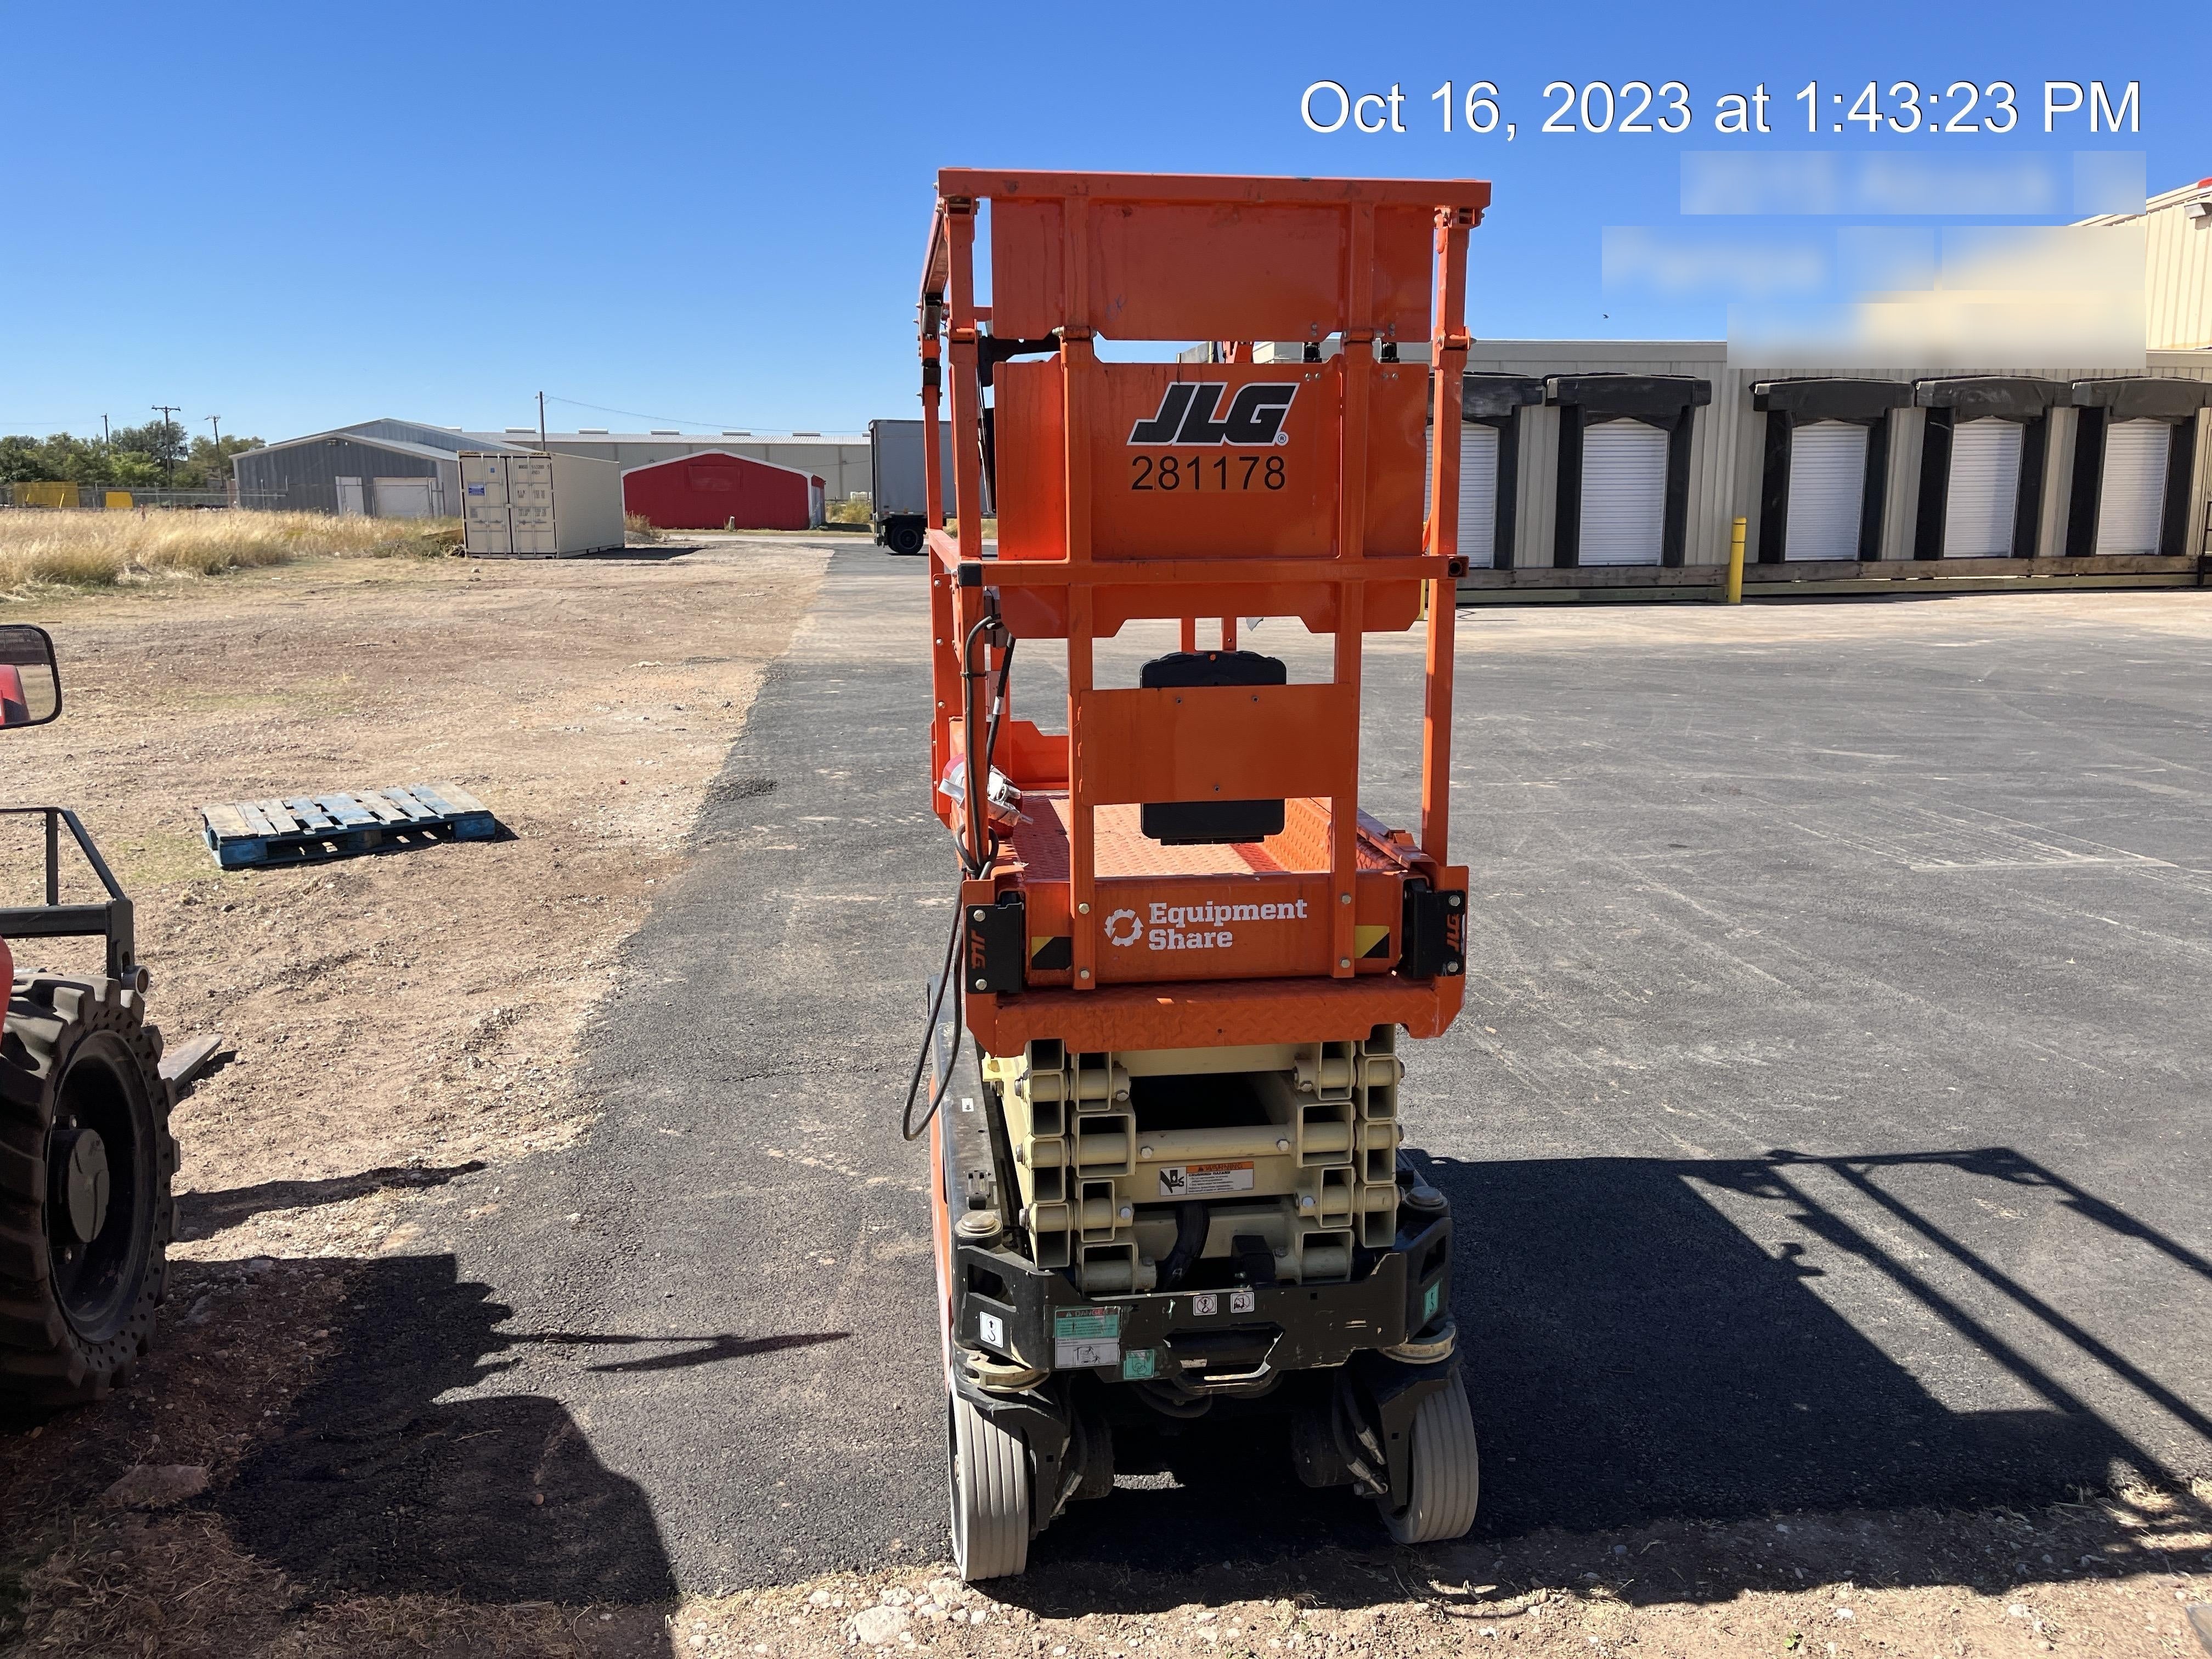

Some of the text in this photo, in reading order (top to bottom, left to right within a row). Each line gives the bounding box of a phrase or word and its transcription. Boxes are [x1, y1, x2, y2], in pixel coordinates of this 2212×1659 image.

[1126, 381, 1300, 446] JLG
[1131, 455, 1285, 490] 281178
[1149, 899, 1307, 928] Equipment
[970, 929, 986, 969] JLG
[1149, 928, 1233, 950] Share
[1446, 913, 1460, 953] JLG
